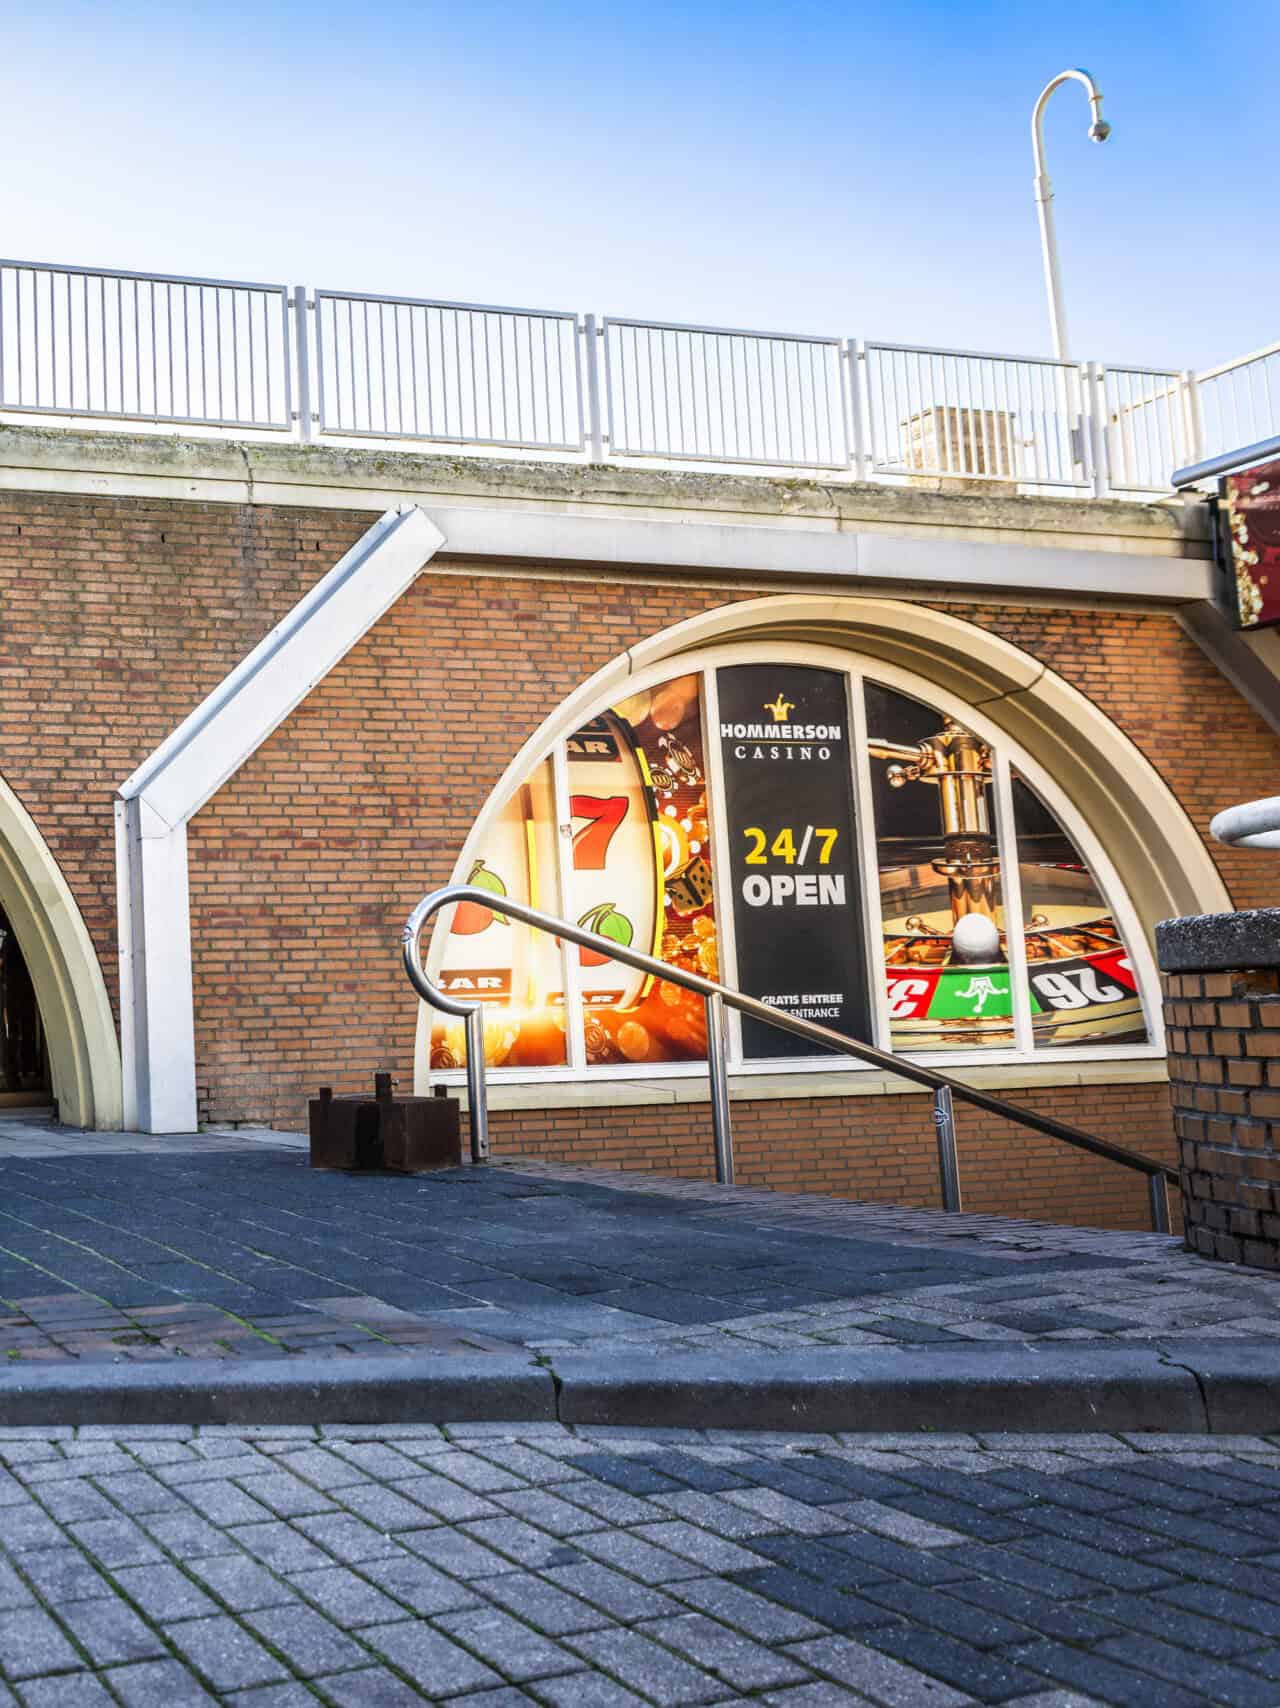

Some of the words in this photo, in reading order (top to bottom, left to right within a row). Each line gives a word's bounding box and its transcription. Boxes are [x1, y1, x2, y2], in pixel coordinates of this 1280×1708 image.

[720, 723, 842, 740] HOMMERSON
[567, 741, 612, 753] AR
[734, 745, 831, 760] CASINO
[570, 795, 629, 870] 7
[743, 825, 839, 866] 24/7
[742, 874, 846, 907] OPEN
[761, 994, 800, 1006] GRATIS
[801, 993, 844, 1005] ENTREE
[888, 978, 929, 1018] 3
